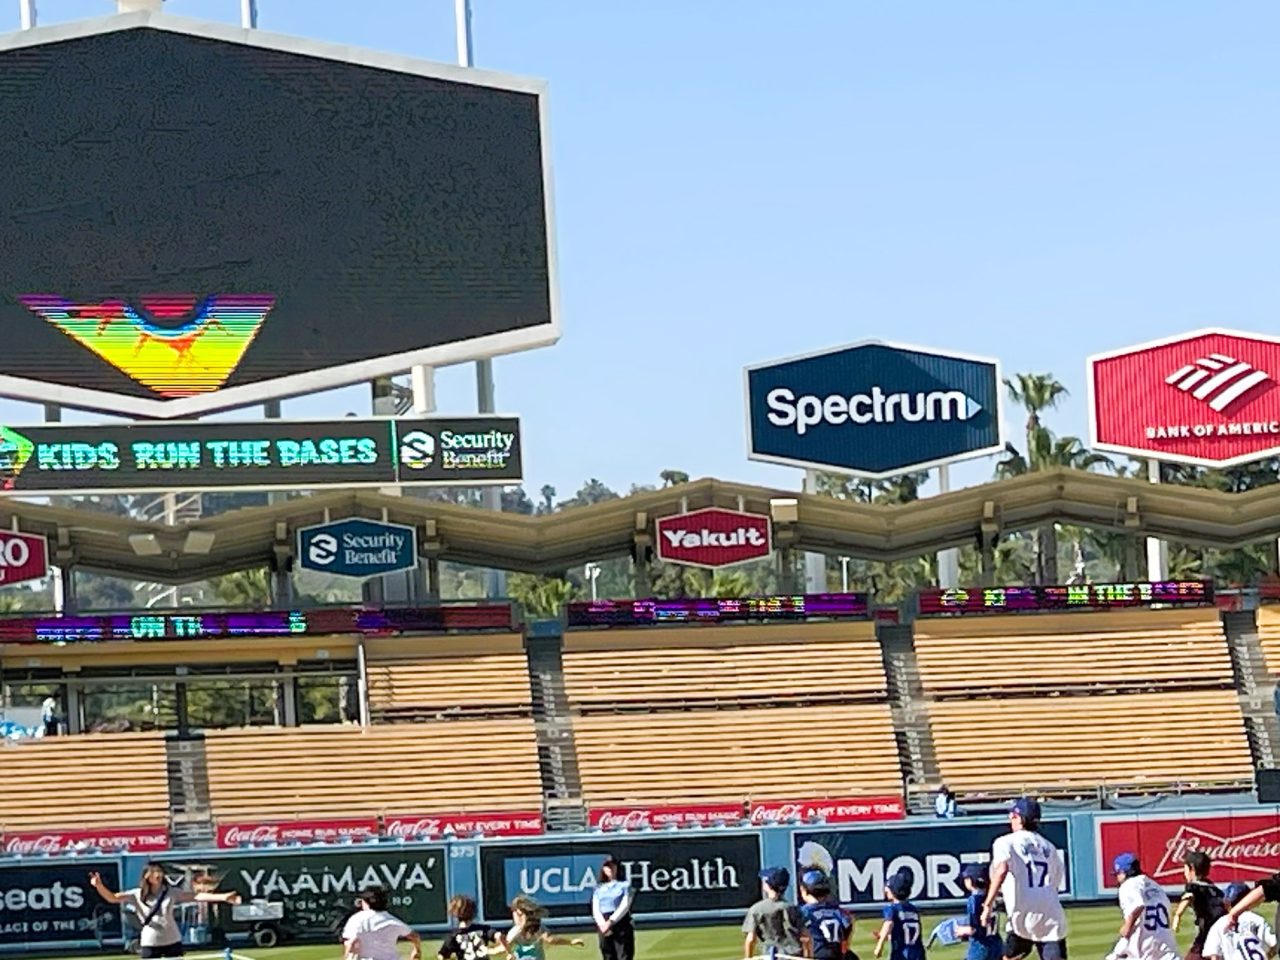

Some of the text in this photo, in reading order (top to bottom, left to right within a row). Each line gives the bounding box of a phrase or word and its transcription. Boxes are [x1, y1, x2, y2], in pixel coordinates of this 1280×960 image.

[767, 386, 967, 435] Spectrum
[440, 430, 514, 451] Security
[1146, 426, 1190, 439] BANK
[1193, 424, 1213, 437] OF
[37, 438, 378, 470] KIDS RUN THE BASES
[442, 449, 510, 469] Benefit
[342, 531, 405, 553] Security
[662, 527, 766, 549] Yakult
[344, 548, 398, 565] Benefit
[598, 810, 652, 831] Coca-Cola
[750, 804, 805, 824] Coca-Cola
[836, 804, 872, 817] EVERY
[873, 802, 902, 814] TIME
[224, 826, 279, 846] Coca-Cola
[387, 818, 441, 837] Coca-Cola
[475, 820, 512, 832] EVERY
[514, 817, 542, 830] TIME
[138, 834, 167, 846] TIME
[450, 845, 475, 858] 375
[520, 856, 739, 894] UCLA Health
[1025, 860, 1049, 888] 17
[32, 920, 48, 932] OF
[52, 918, 75, 931] THE
[1143, 903, 1170, 931] 50
[819, 919, 841, 943] 17
[902, 921, 920, 945] 17
